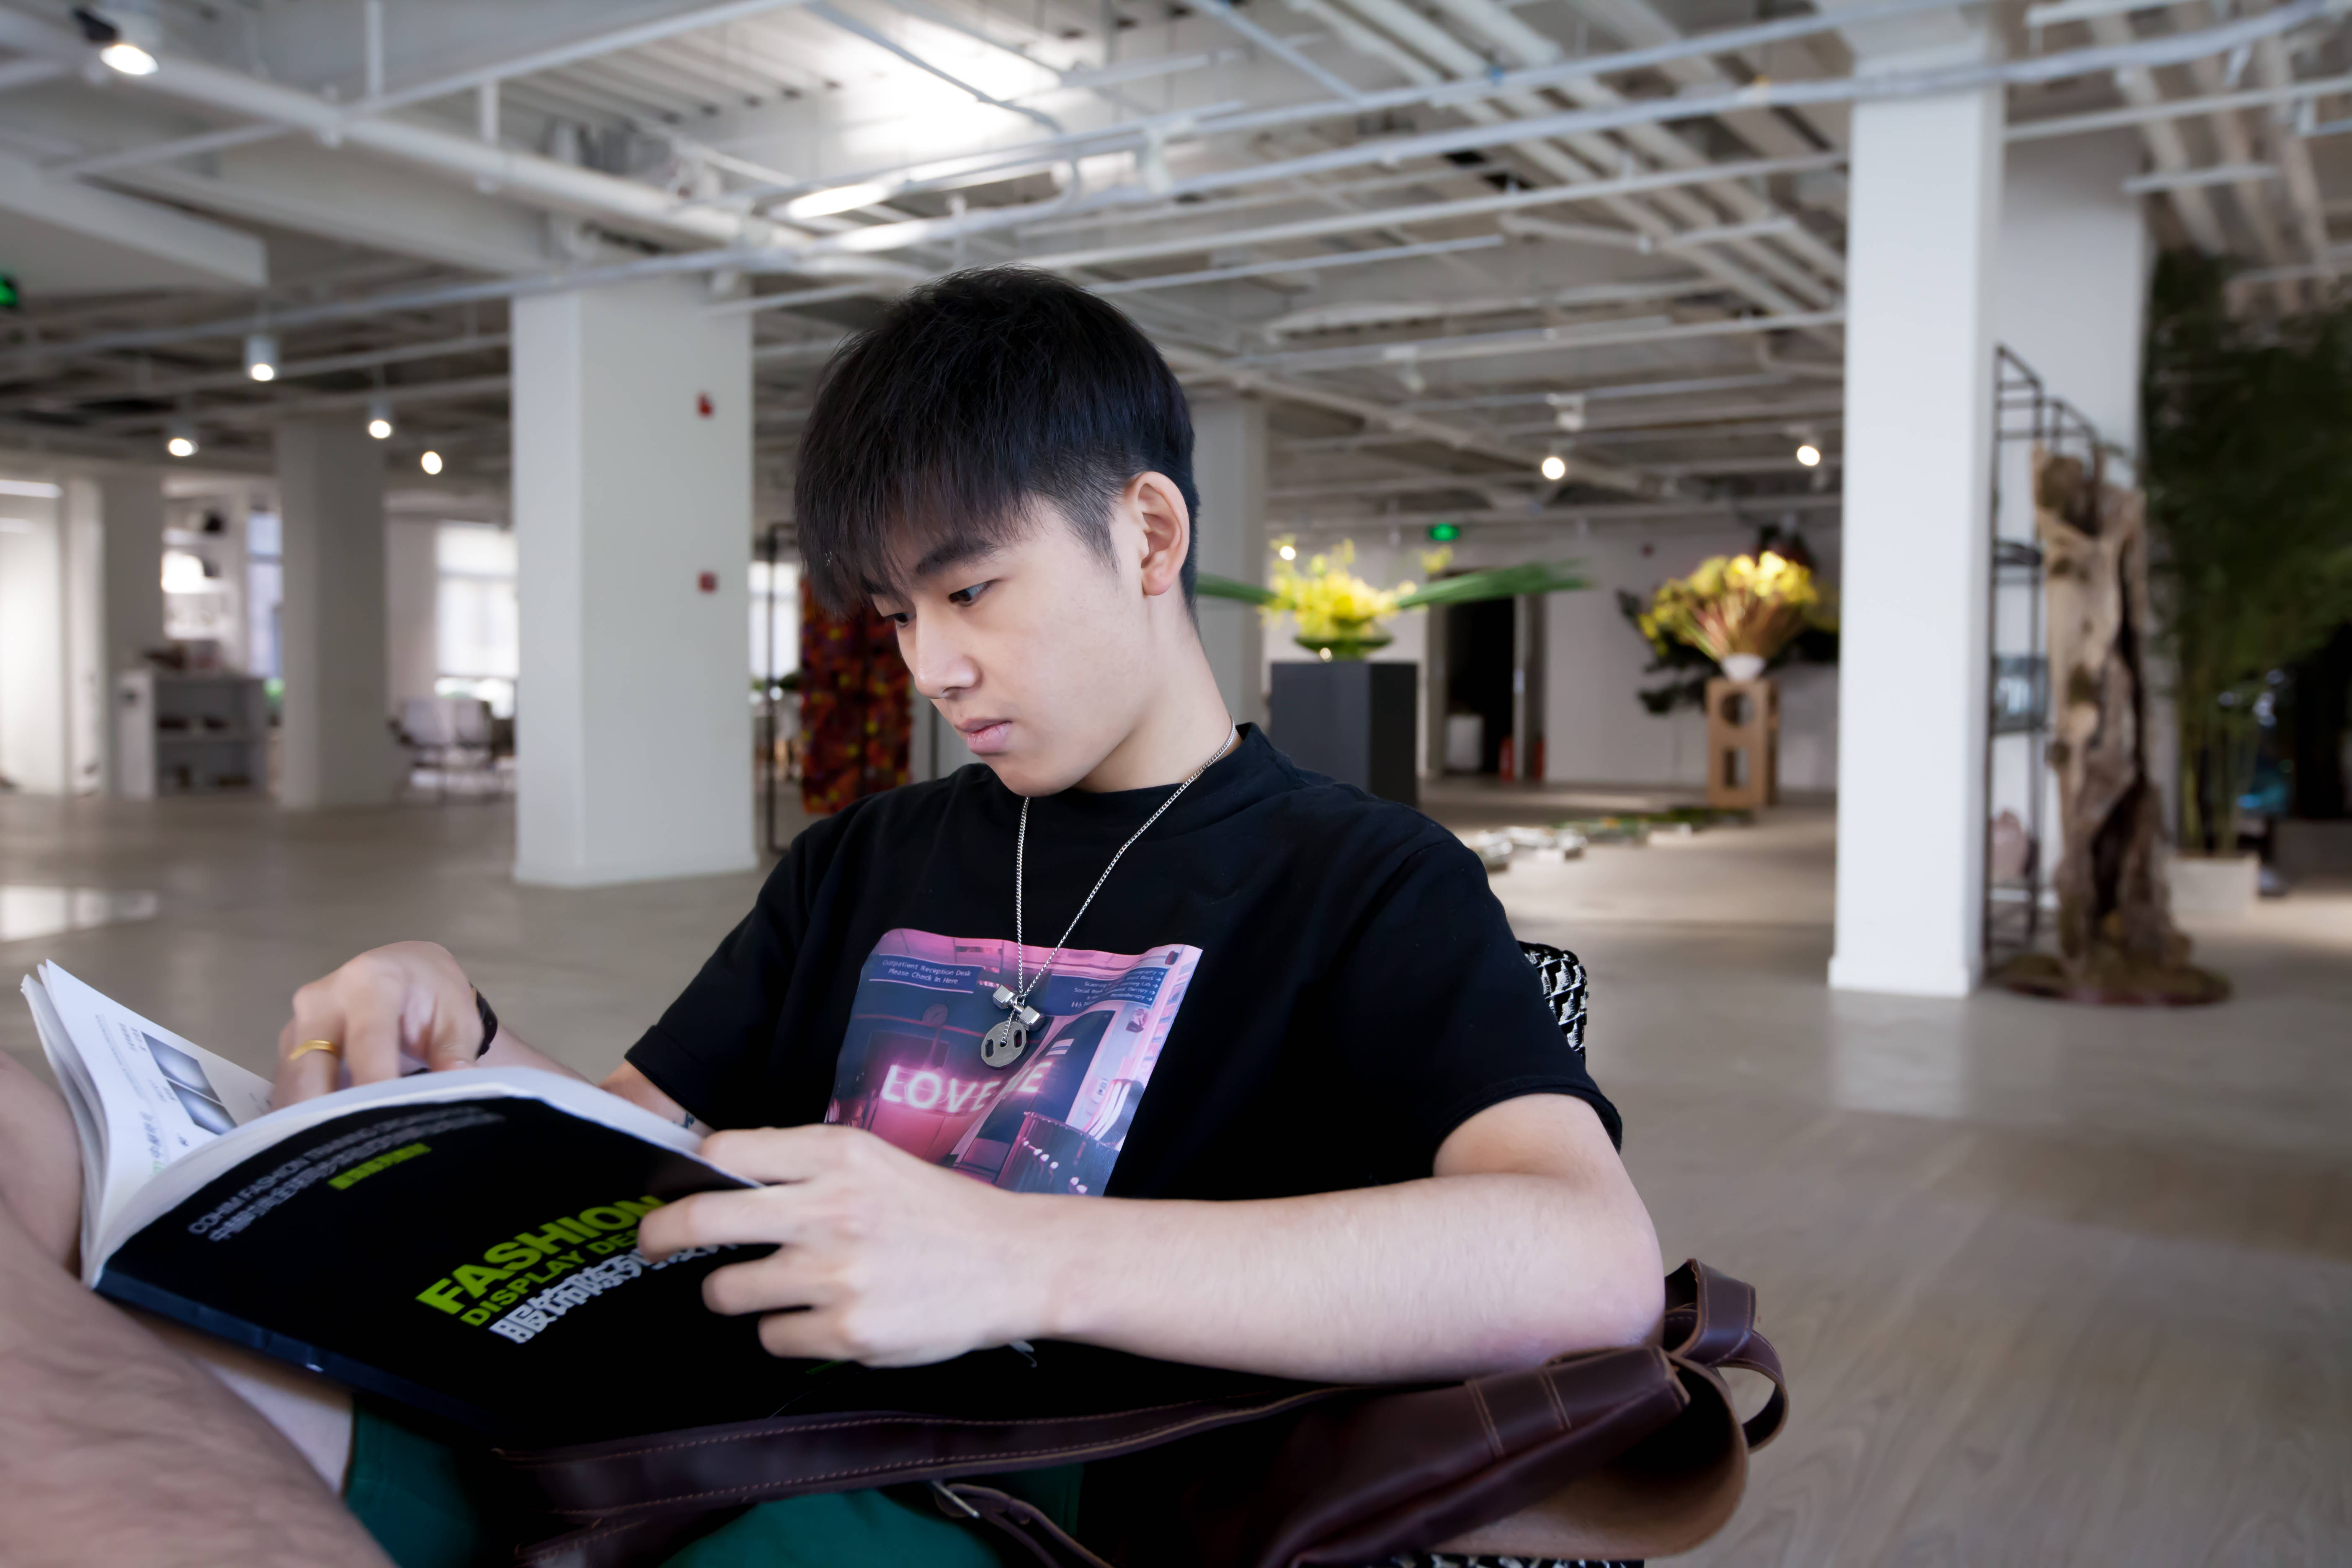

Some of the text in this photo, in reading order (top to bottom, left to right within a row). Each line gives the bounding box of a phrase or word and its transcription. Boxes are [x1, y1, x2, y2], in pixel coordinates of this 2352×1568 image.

[888, 968, 909, 977] Please
[911, 972, 932, 981] Check
[880, 1064, 1001, 1113] LOVE
[415, 1195, 667, 1315] FASHION
[460, 1250, 586, 1327] DISPLAY
